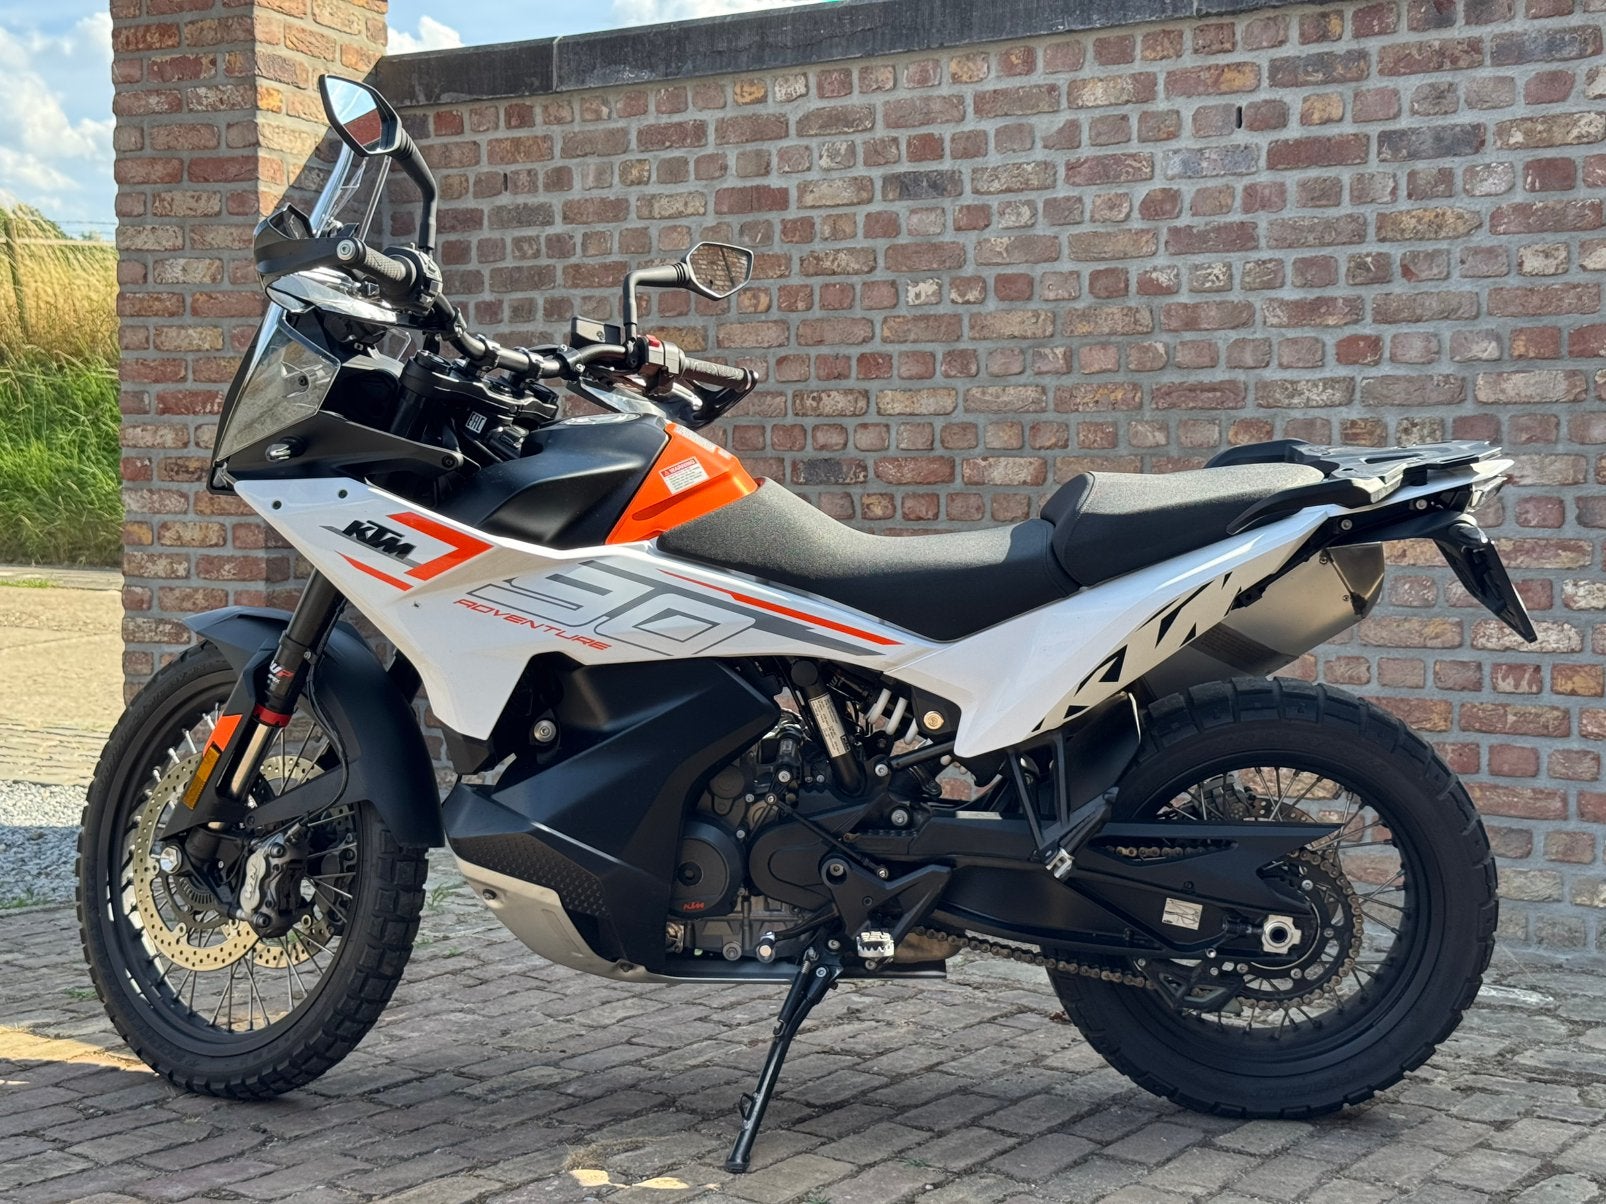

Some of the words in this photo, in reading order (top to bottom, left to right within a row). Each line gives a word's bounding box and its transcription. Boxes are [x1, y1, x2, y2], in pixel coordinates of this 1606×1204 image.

[342, 520, 417, 560] KTM
[453, 599, 612, 650] ADVENTURE
[467, 559, 756, 656] 90
